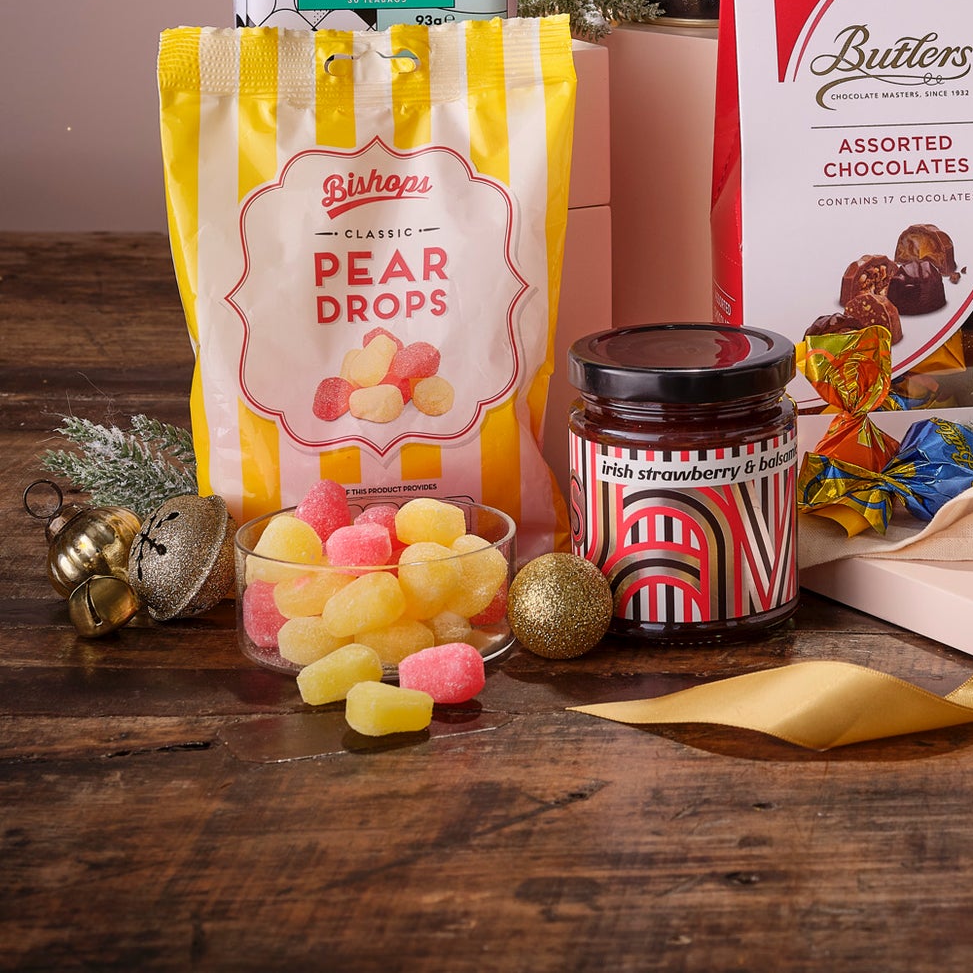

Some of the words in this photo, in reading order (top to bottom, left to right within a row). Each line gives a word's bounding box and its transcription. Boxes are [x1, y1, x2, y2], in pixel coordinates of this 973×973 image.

[810, 24, 973, 84] Butlers
[830, 92, 879, 101] CHOCOLATE
[951, 89, 970, 97] 1932
[838, 135, 953, 154] ASSORTED
[823, 158, 970, 178] CHOCOLATES
[321, 169, 433, 208] Bishops
[817, 196, 879, 207] CONTAINS
[884, 195, 895, 204] 17
[345, 228, 412, 239] CLASSIC
[314, 247, 449, 287] PEAR
[316, 288, 447, 324] DROPS
[602, 460, 634, 479] irish
[638, 465, 741, 482] strawberry
[744, 460, 756, 474] &
[368, 486, 402, 494] PRODUCT
[403, 483, 438, 492] PROVIDES
